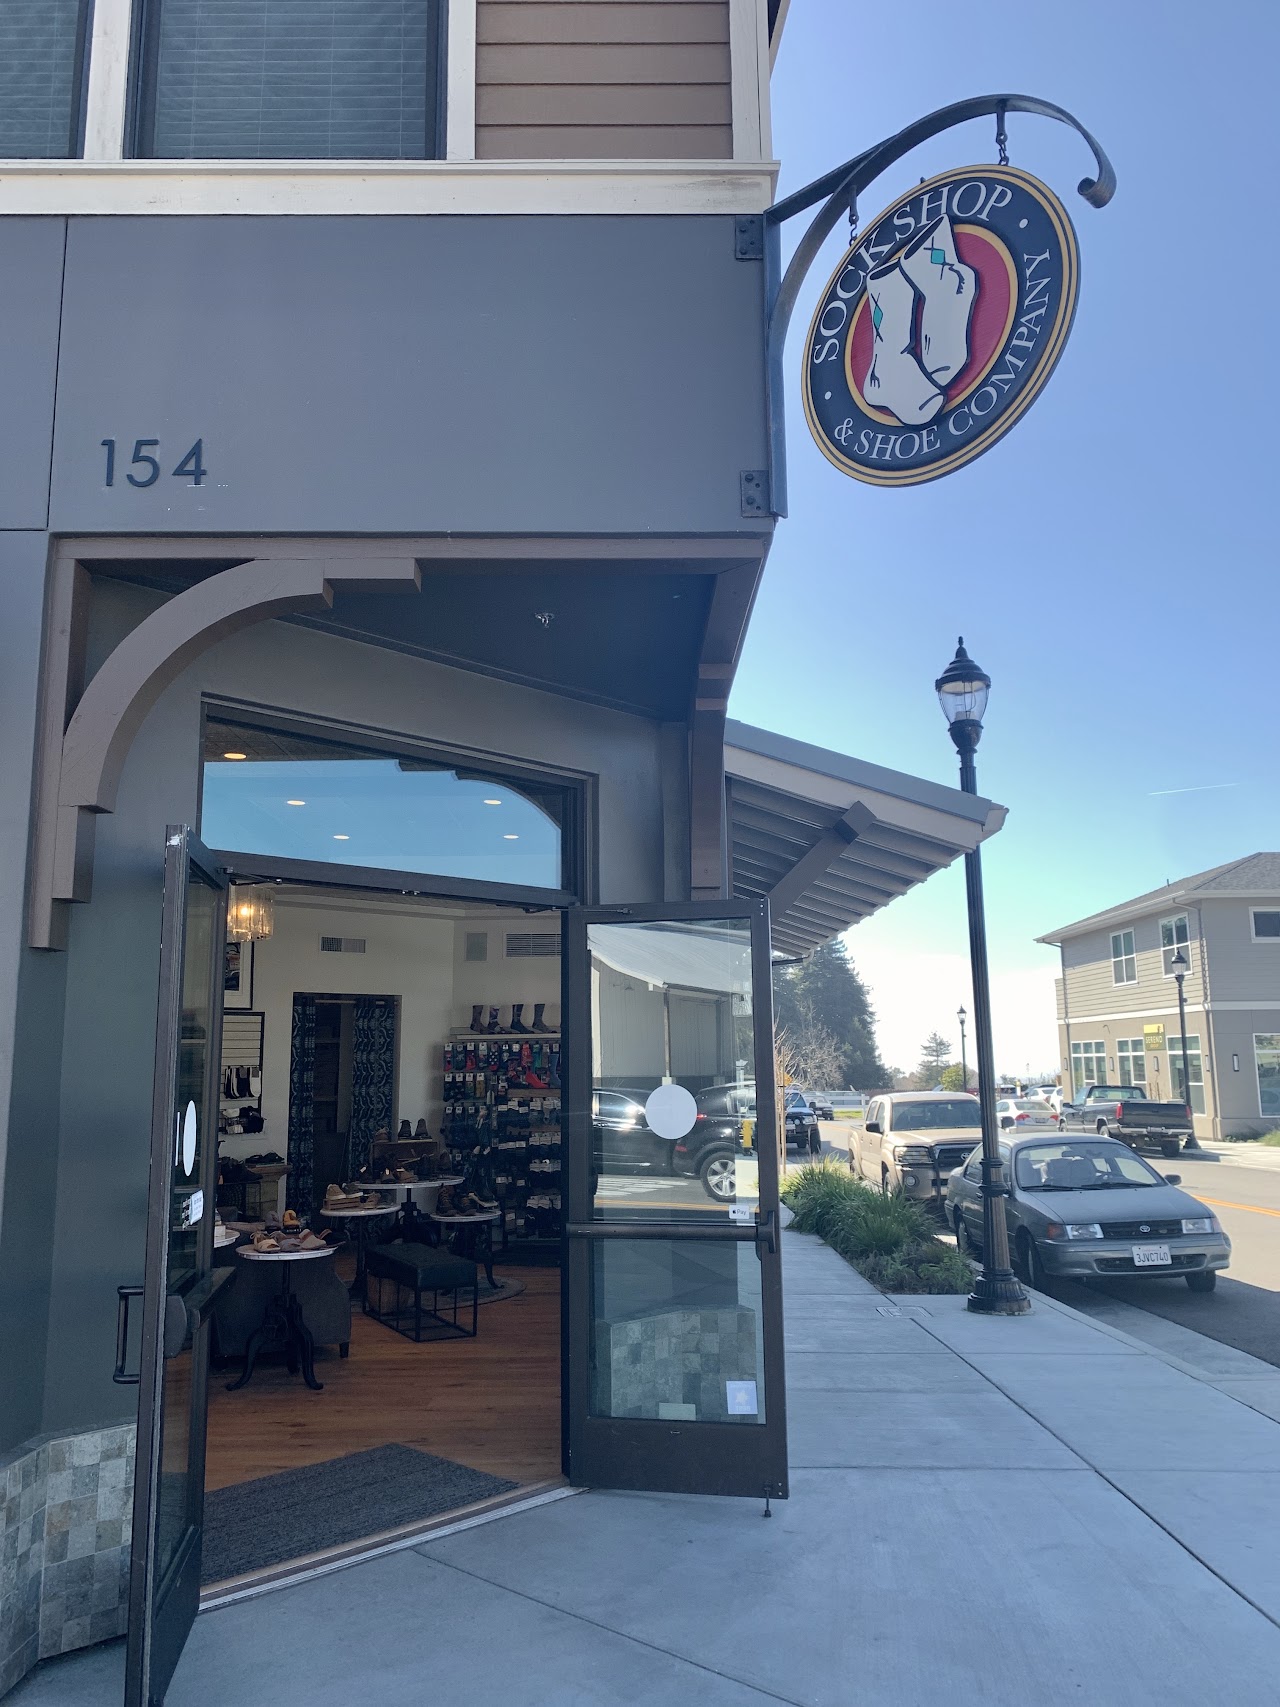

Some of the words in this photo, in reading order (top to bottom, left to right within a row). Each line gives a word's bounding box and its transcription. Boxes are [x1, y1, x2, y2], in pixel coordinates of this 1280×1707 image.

[834, 418, 853, 445] &
[854, 425, 940, 460] SHOE
[949, 249, 1050, 435] COMPANY
[101, 438, 207, 487] 154
